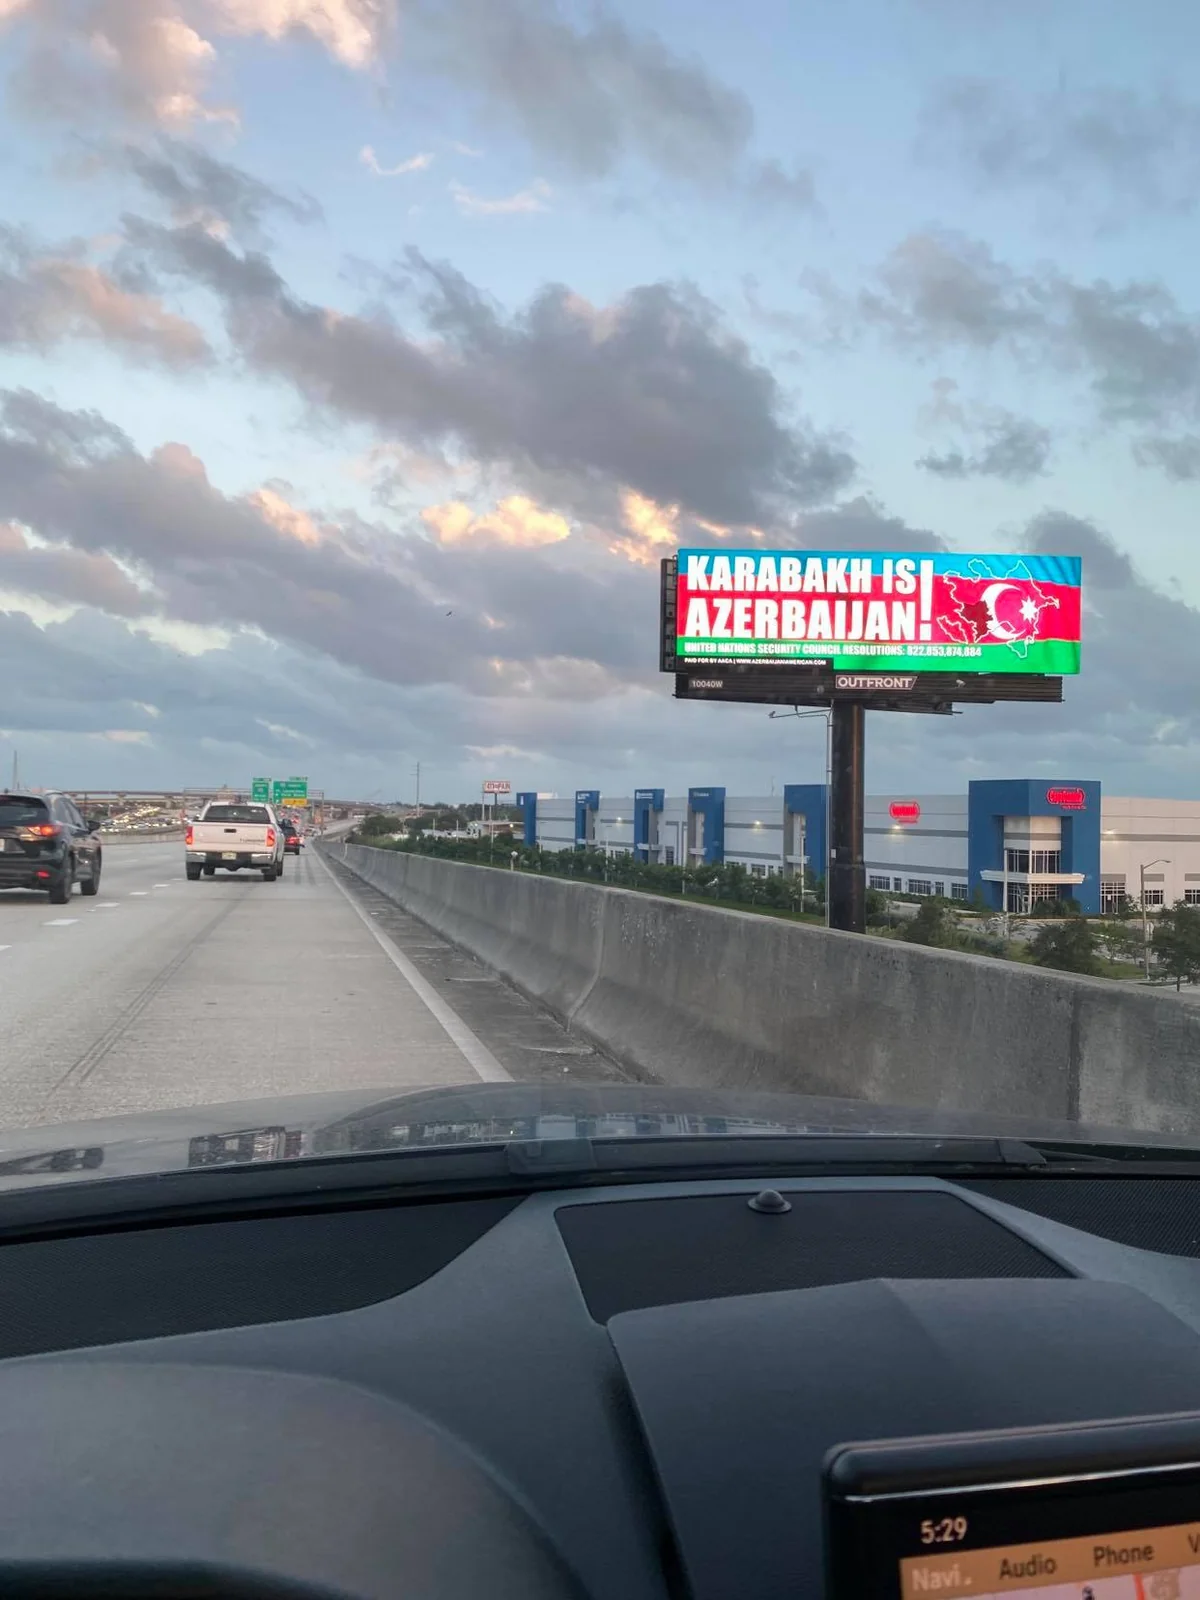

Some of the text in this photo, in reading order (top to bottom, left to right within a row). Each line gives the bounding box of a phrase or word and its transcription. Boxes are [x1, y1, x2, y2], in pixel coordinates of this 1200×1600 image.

[687, 556, 916, 594] KARABAKH IS
[684, 642, 716, 653] UNITED
[718, 643, 756, 654] NATIONS
[758, 643, 801, 654] SECURITY
[803, 644, 841, 655] COUNCIL
[843, 645, 904, 656] RESOLUTIONS:
[692, 680, 724, 688] 10040W
[838, 676, 913, 689] OUTFRONT
[920, 1516, 968, 1544] 5:29
[1000, 1553, 1057, 1580] Audio
[1093, 1544, 1155, 1567] Phone
